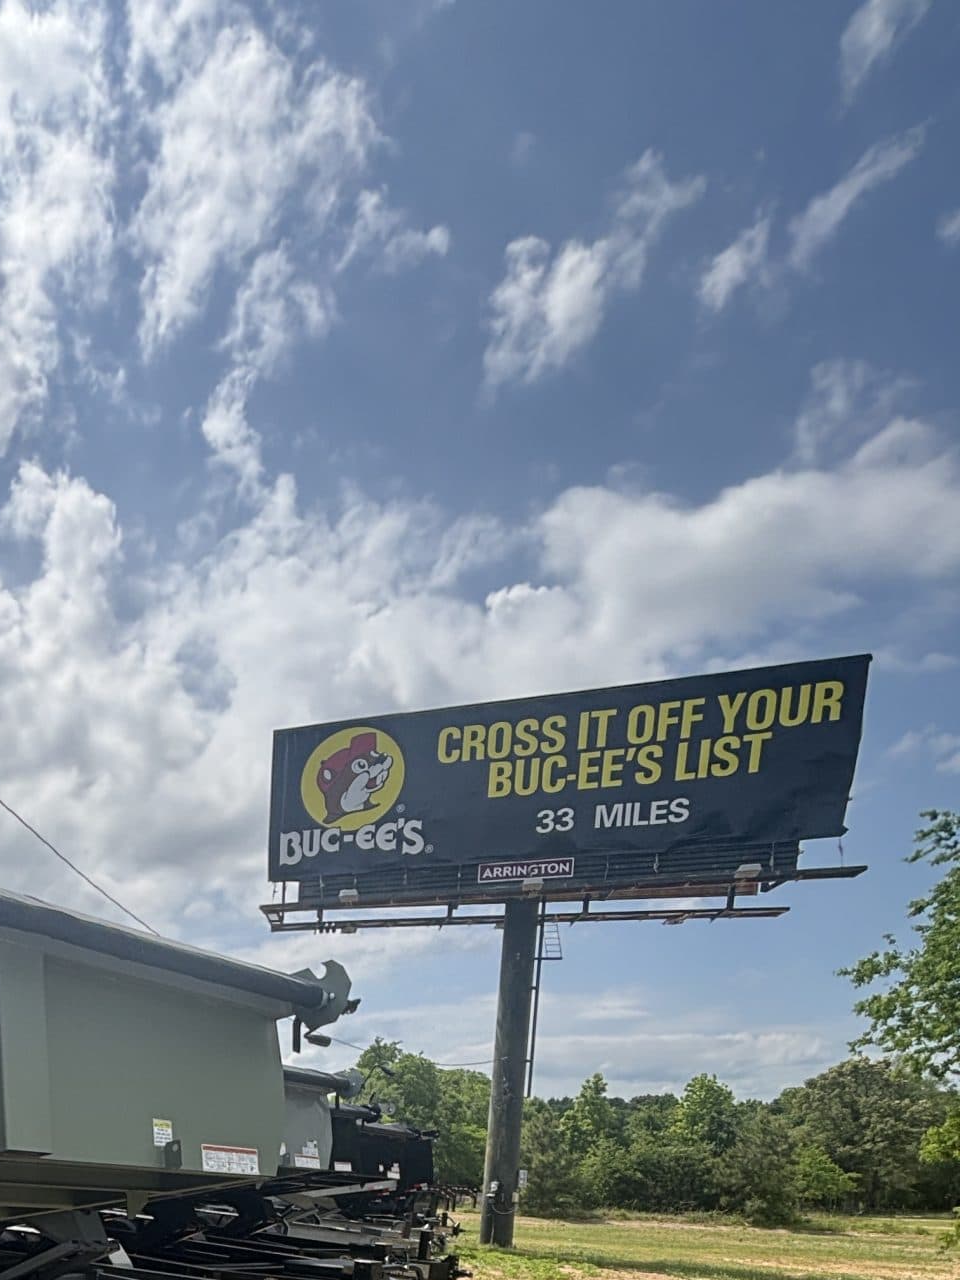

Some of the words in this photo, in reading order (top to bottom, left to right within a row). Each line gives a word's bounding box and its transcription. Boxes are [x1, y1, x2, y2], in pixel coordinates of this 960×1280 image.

[437, 715, 567, 764] CROSS
[577, 709, 618, 750] IT
[627, 697, 706, 744] OFF
[717, 680, 845, 735] YOUR
[487, 744, 664, 798] BUC-EE'S
[674, 731, 773, 781] LIST
[535, 807, 575, 834] 33
[594, 797, 690, 829] MILES
[279, 818, 425, 867] BUC-EE'S
[482, 862, 570, 879] ARRINGTON
